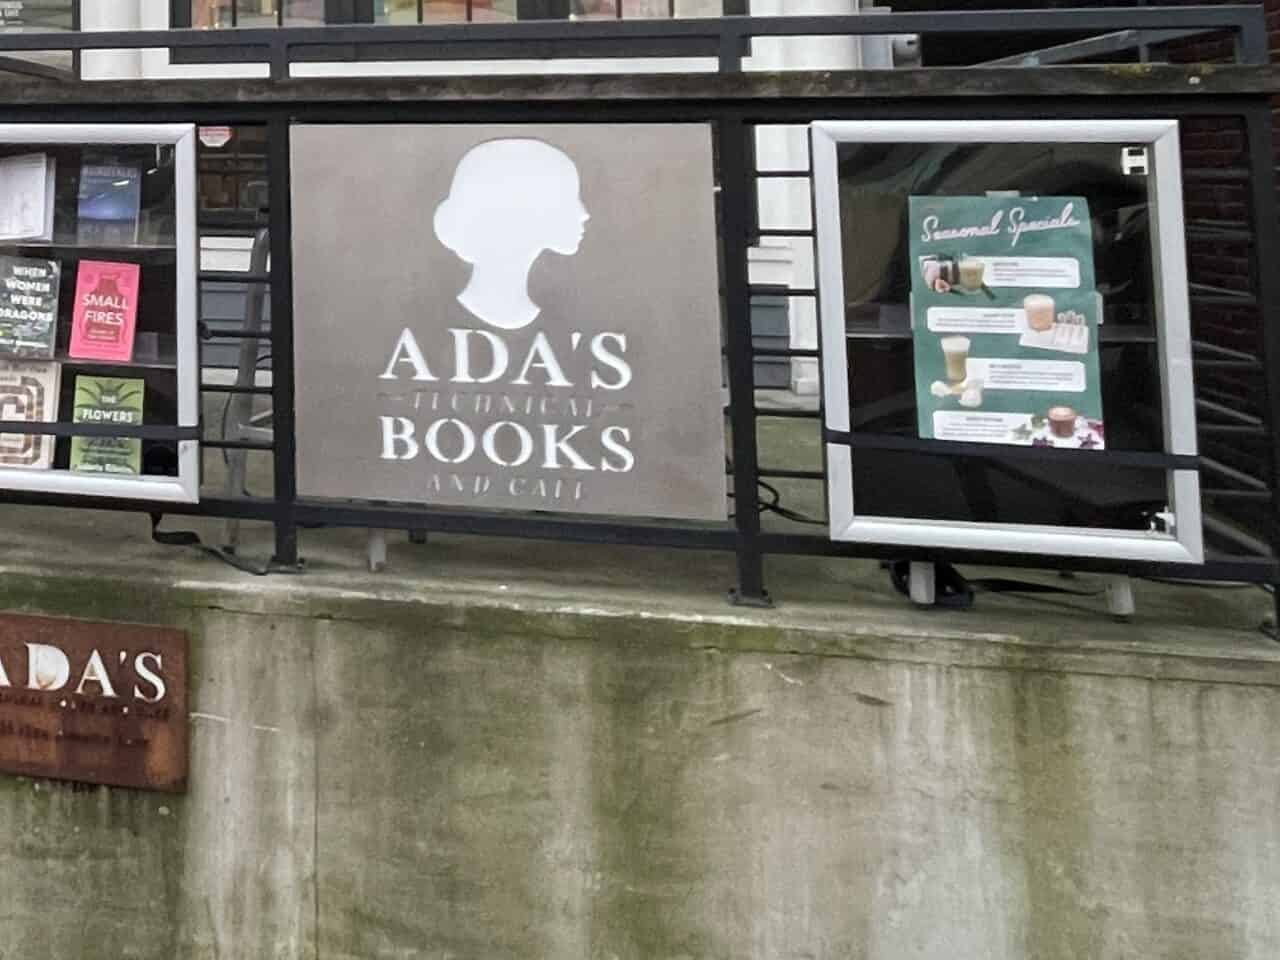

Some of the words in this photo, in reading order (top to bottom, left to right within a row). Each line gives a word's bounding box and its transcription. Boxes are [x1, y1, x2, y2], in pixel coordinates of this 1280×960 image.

[921, 209, 1004, 243] Seasonal
[12, 265, 46, 278] WHEN
[4, 278, 51, 293] WOMEN
[82, 294, 128, 310] SMALL
[83, 310, 124, 325] FIRES
[377, 327, 633, 390] ADA'S
[82, 408, 133, 423] FLOWERS
[378, 415, 635, 473] BOOKS
